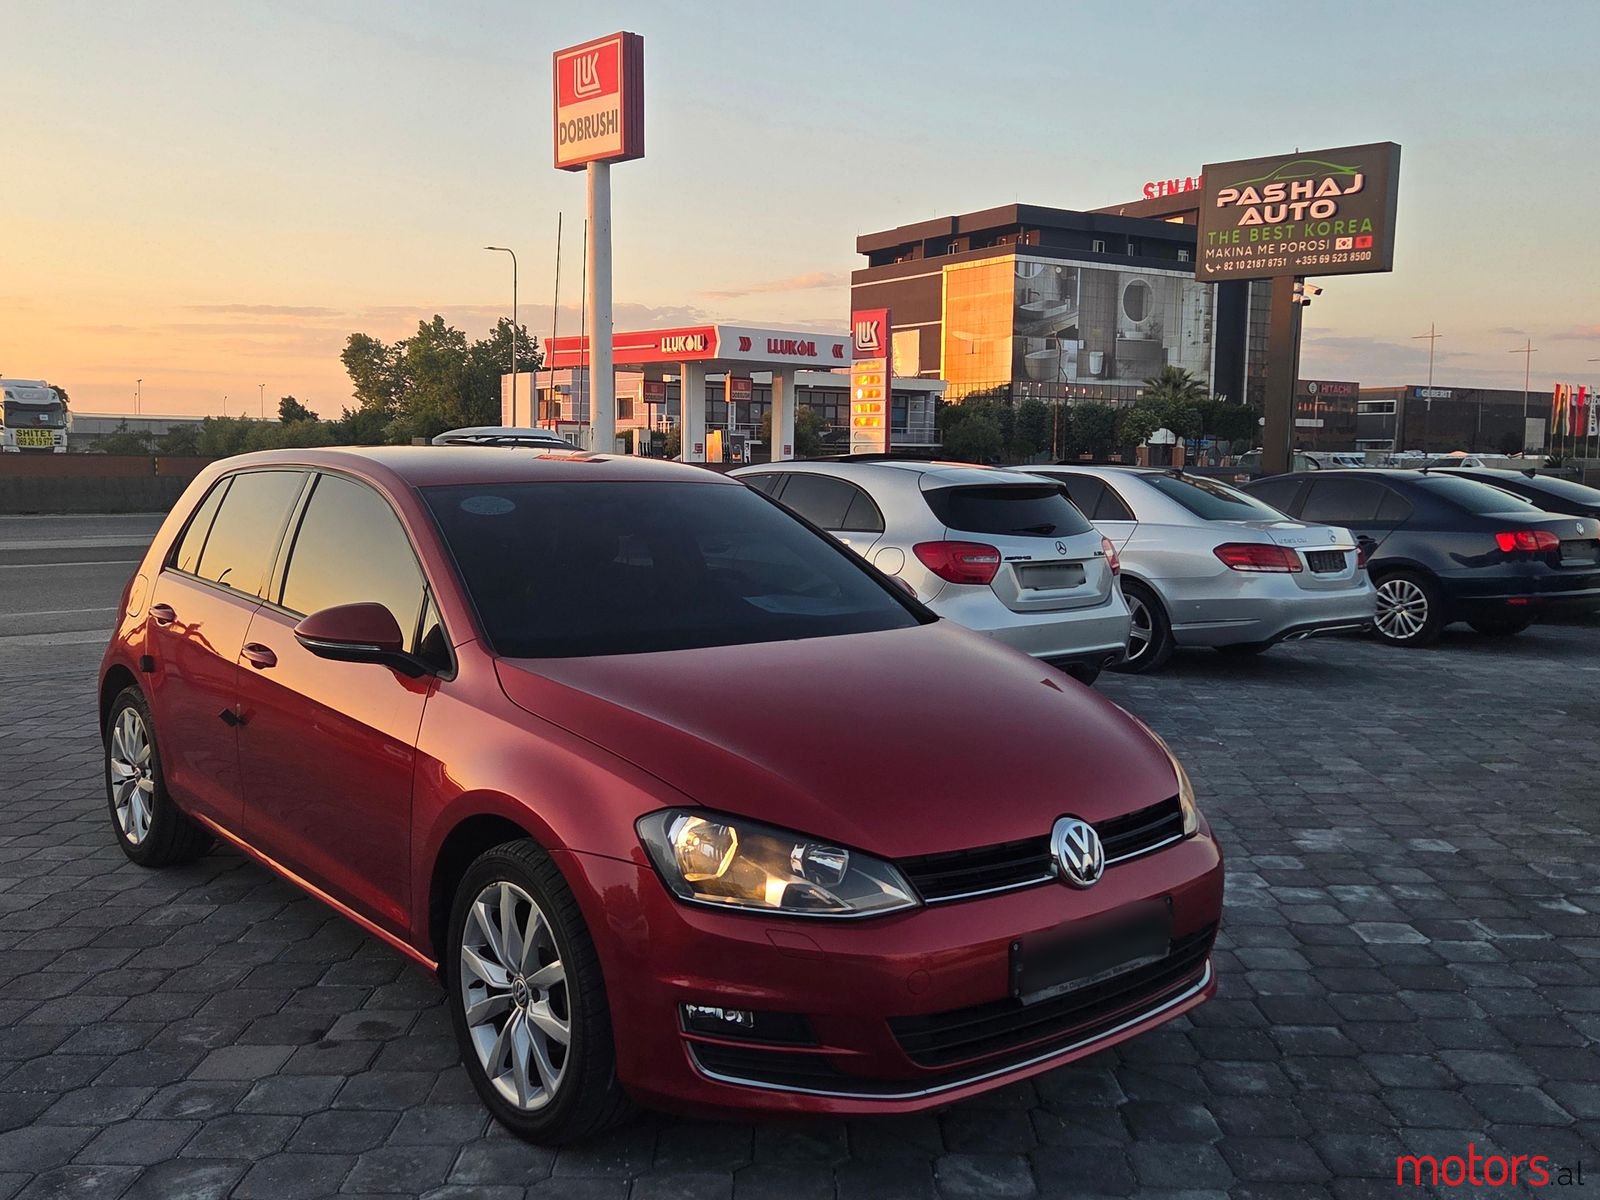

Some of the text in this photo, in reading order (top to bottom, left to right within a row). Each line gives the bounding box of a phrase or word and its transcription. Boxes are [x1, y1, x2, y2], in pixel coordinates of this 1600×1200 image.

[559, 108, 618, 146] DOBRUSHI
[1216, 173, 1364, 208] PASHAJ
[1237, 199, 1337, 226] AUTO
[1207, 218, 1373, 246] THE BEST KOREA
[1205, 239, 1330, 259] MAKINA ME POROSI
[1223, 260, 1233, 271] 82
[1235, 259, 1245, 270] 10
[1246, 258, 1266, 269] 2187
[1267, 257, 1287, 268] 8751
[1295, 255, 1317, 266] +355
[1319, 254, 1330, 264] 69
[1331, 252, 1348, 263] 523
[1350, 251, 1372, 262] 8500
[1321, 383, 1352, 393] HITACHI
[16, 429, 52, 437] SHITET
